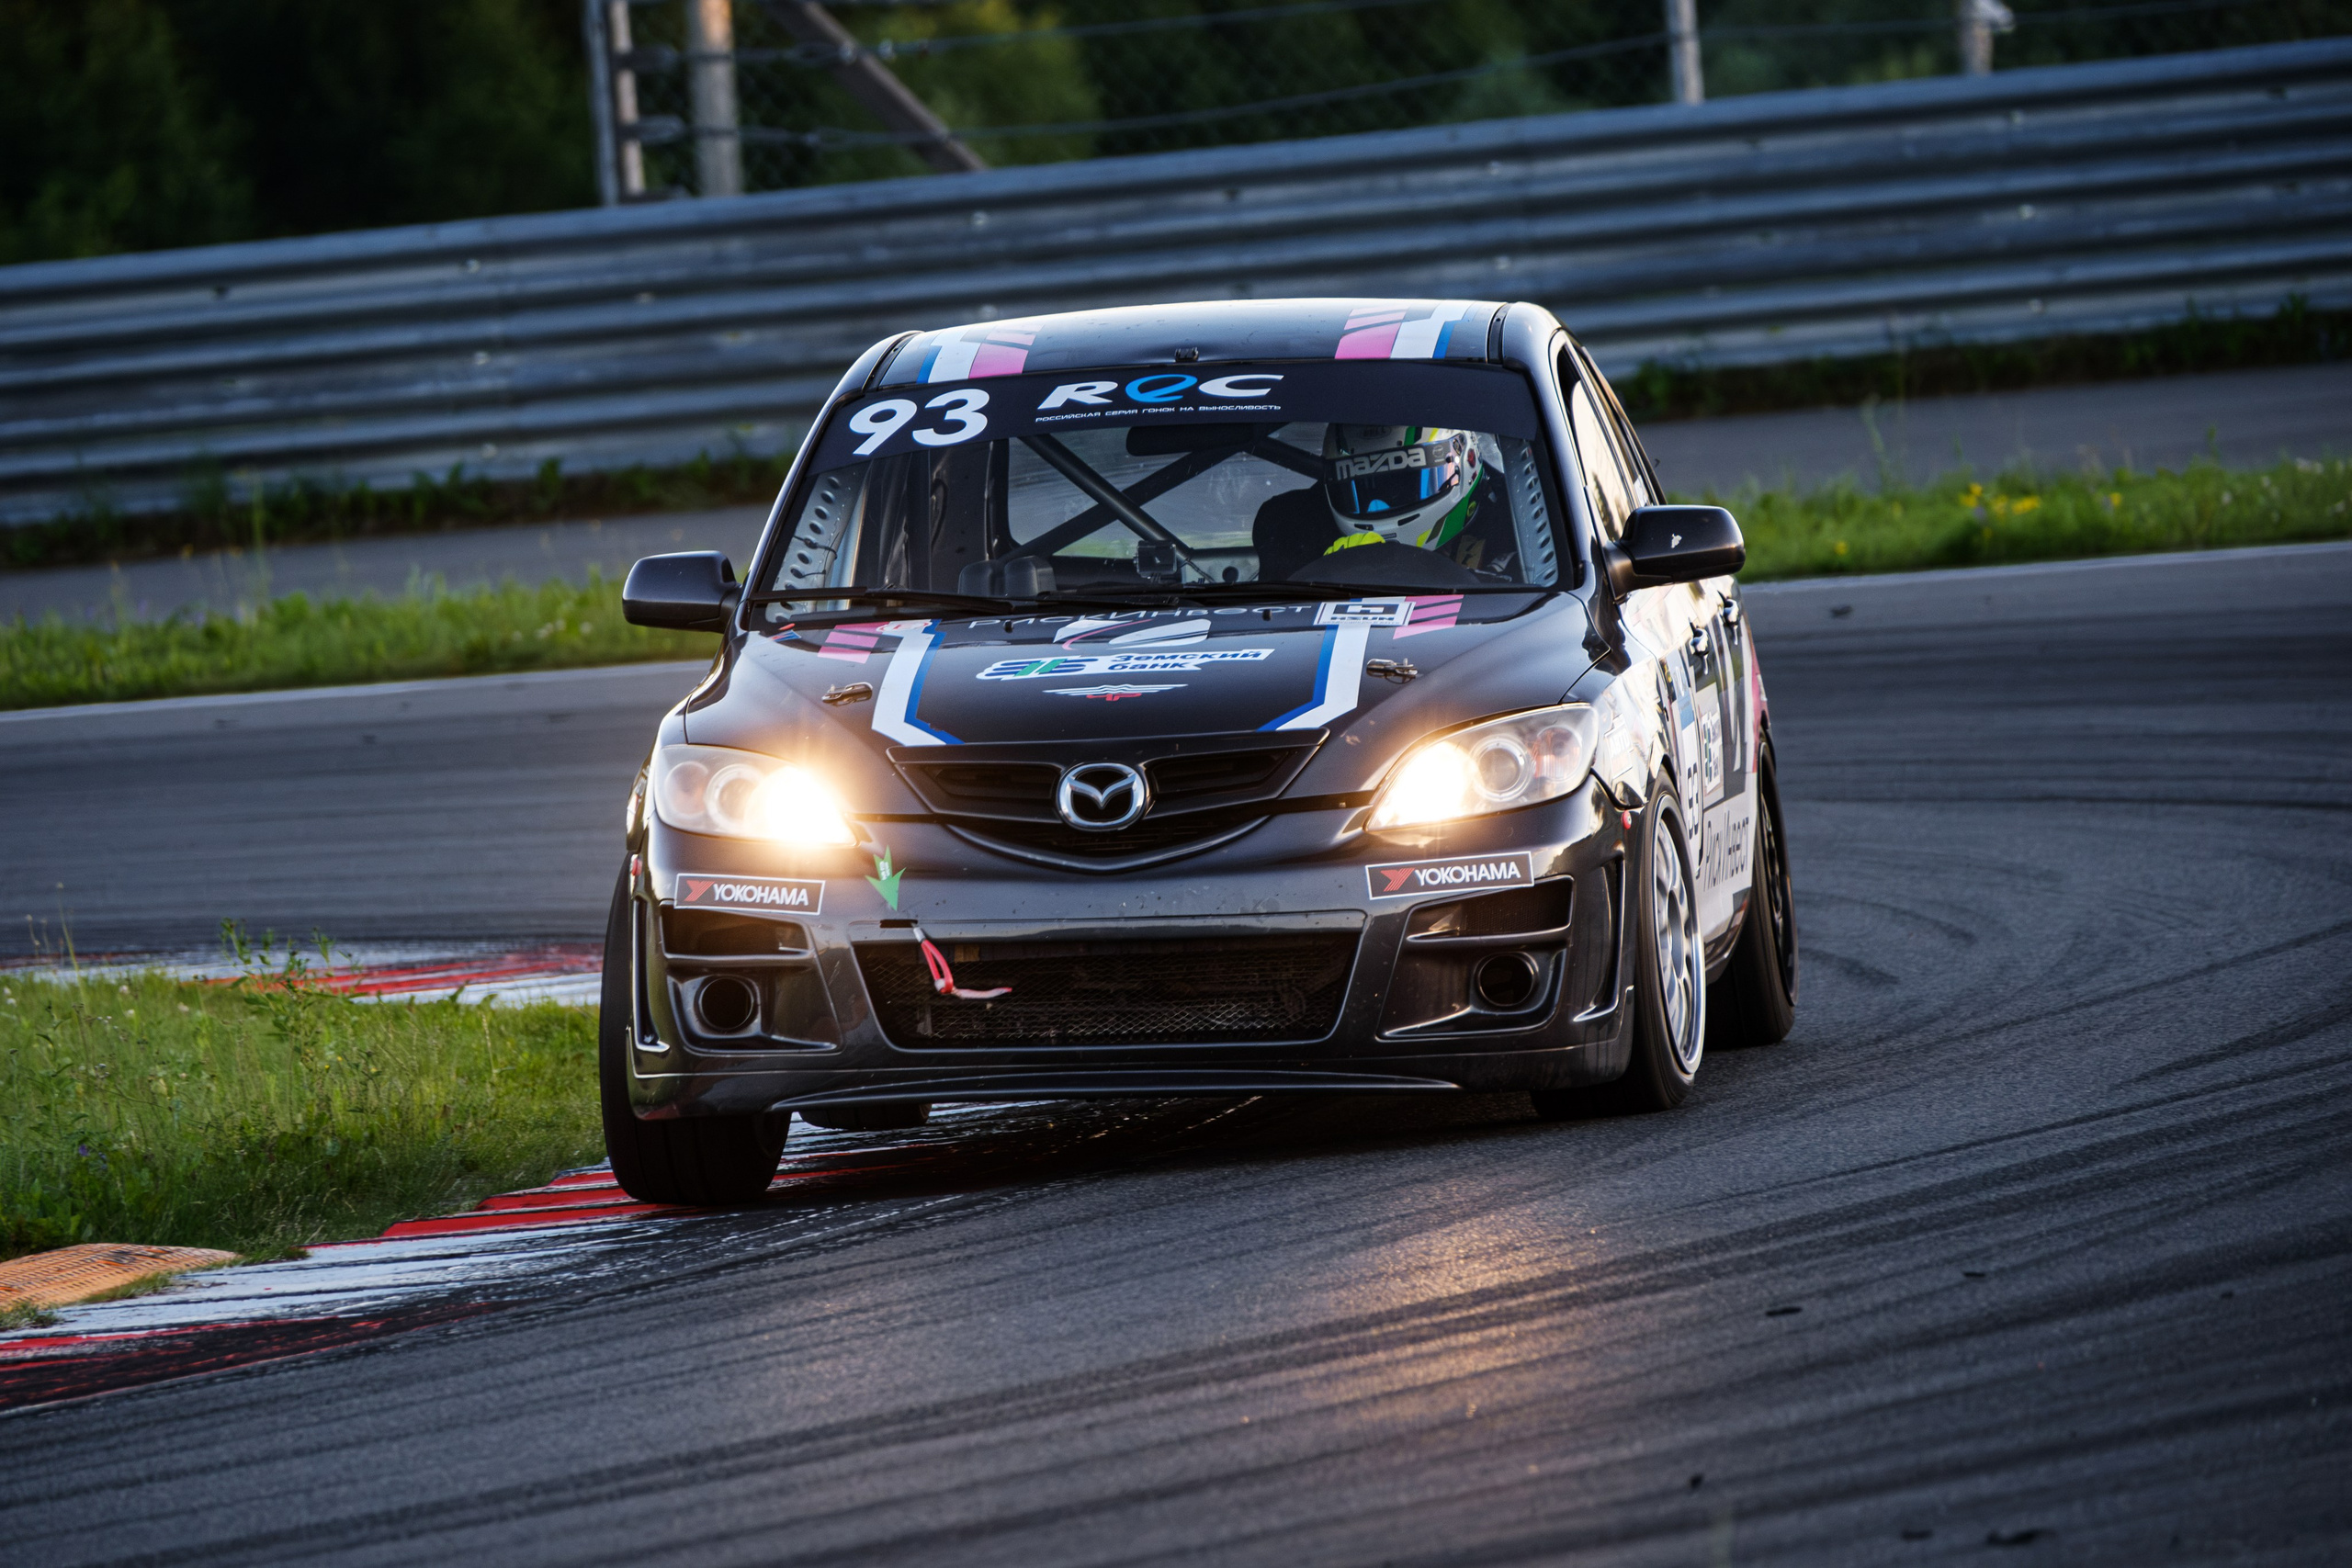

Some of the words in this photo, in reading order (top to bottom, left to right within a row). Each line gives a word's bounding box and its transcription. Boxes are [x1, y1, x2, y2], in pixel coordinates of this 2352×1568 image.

[849, 388, 989, 456] 93
[1035, 412, 1101, 423] РОССИЙСКАЯ
[1104, 409, 1138, 417] СЕРИЯ
[1110, 649, 1263, 662] Земский
[1107, 660, 1191, 671] банк
[1415, 860, 1521, 887] YOKOHAMA
[712, 882, 809, 907] YOKOHAMA
